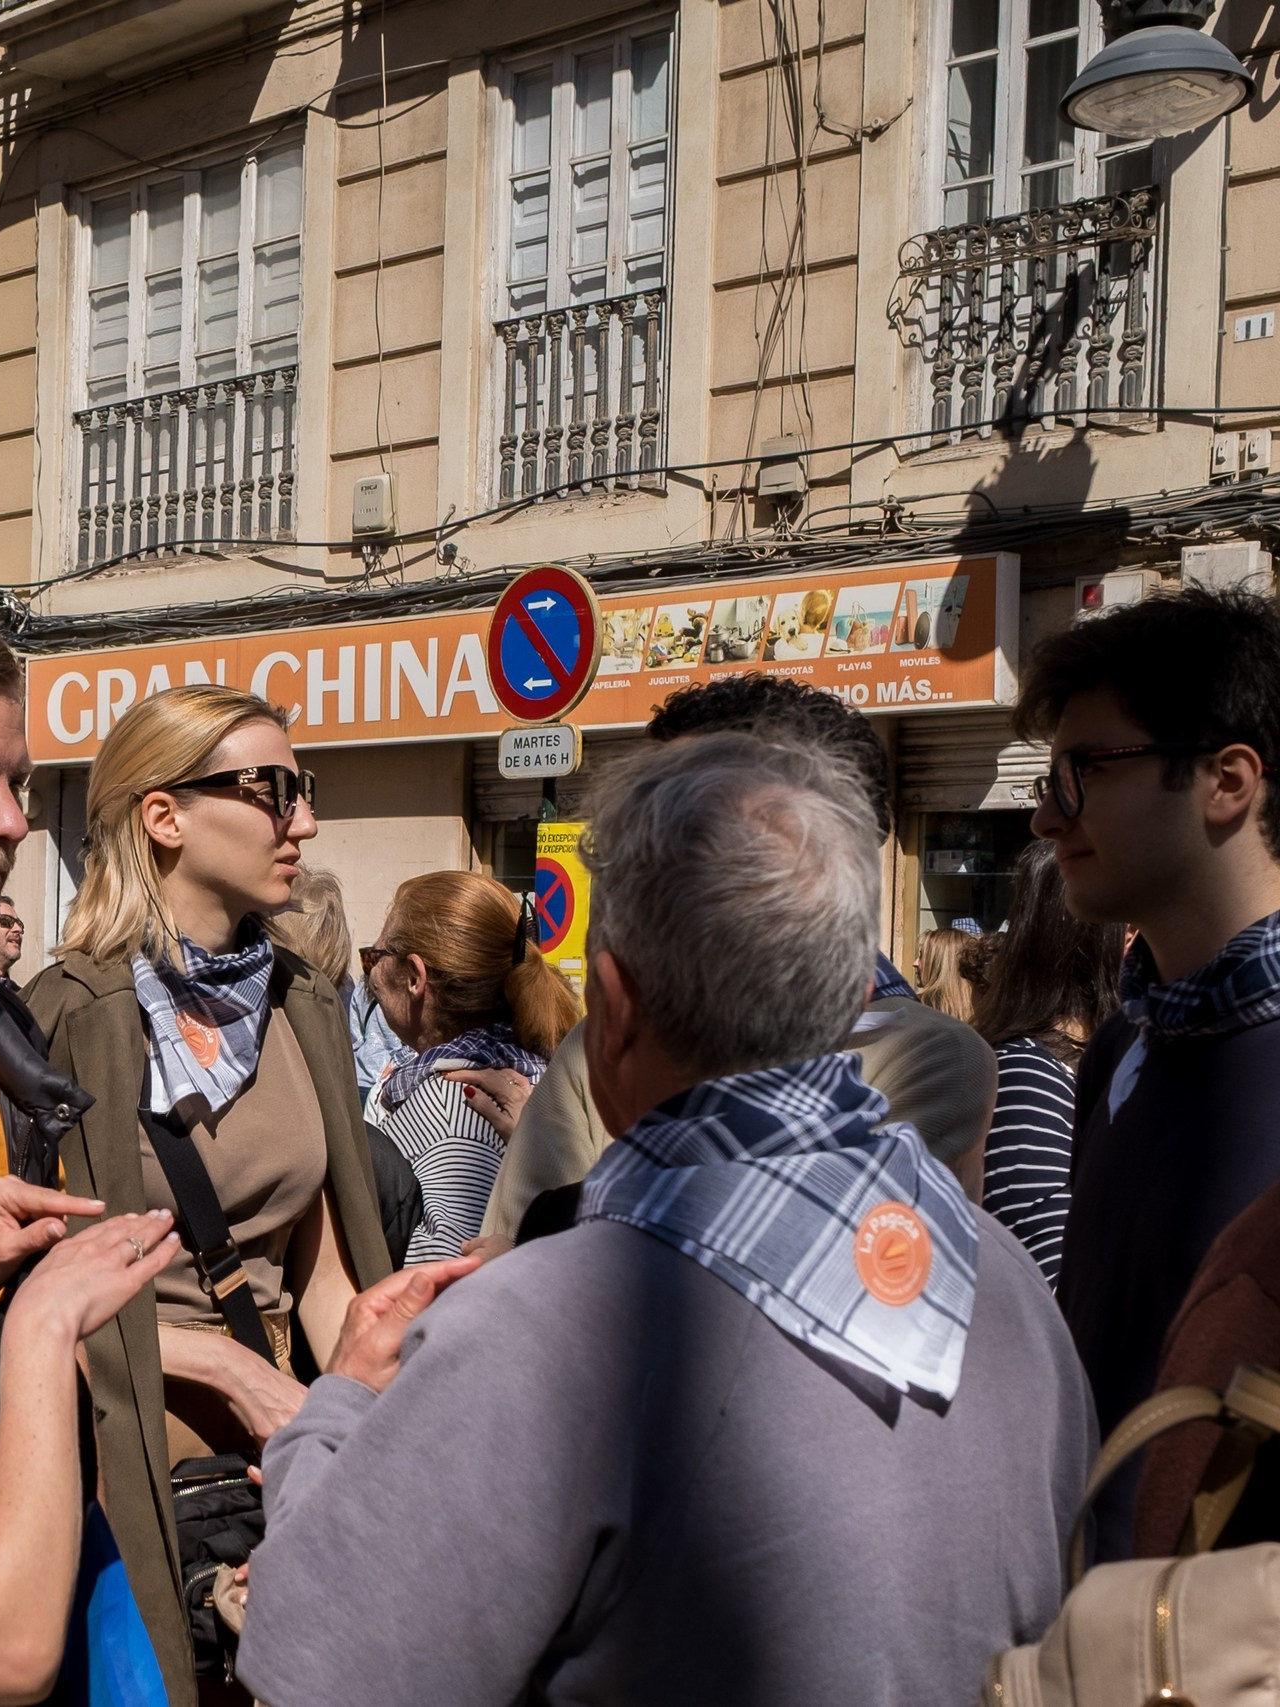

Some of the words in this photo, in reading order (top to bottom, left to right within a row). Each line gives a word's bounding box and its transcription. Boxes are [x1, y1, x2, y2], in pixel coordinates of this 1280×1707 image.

[250, 633, 500, 728] CHINA
[590, 679, 631, 690] PAPELERIA
[648, 675, 690, 686] JUGUETES
[766, 665, 814, 676] MASCOTAS
[837, 661, 873, 672] PLAYAS
[899, 656, 941, 668] MOVILES
[876, 675, 953, 704] MÁS...
[513, 734, 561, 750] MARTES
[505, 755, 520, 768] DE
[523, 755, 531, 767] 8
[534, 754, 542, 767] A
[545, 753, 557, 766] 16
[561, 752, 569, 765] H
